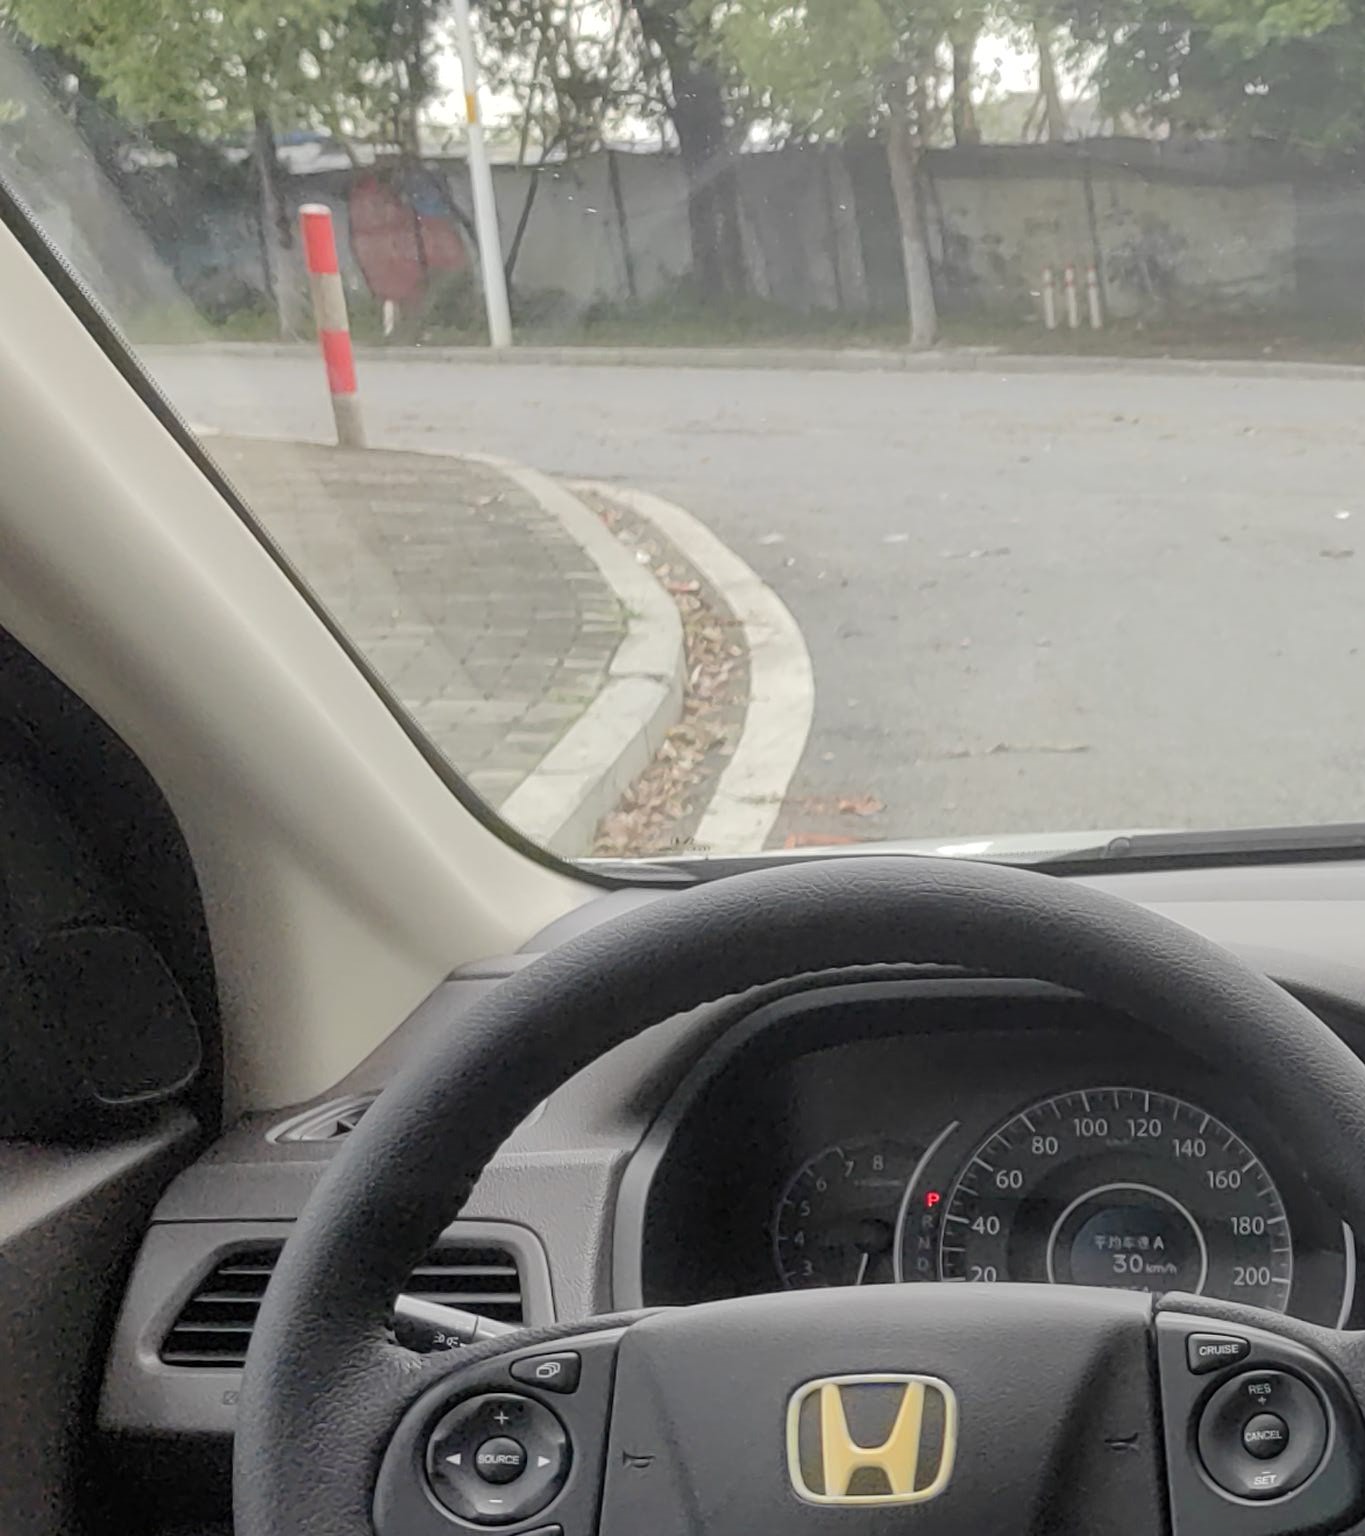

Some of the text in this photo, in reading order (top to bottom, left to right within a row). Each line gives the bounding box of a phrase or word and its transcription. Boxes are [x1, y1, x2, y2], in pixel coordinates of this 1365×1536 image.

[1074, 1118, 1108, 1136] 100
[1128, 1118, 1162, 1137] 120
[1032, 1136, 1058, 1155] 80
[1173, 1139, 1206, 1157] 140
[845, 1160, 855, 1177] 7
[872, 1155, 884, 1171] 8
[816, 1178, 828, 1192] 6
[996, 1170, 1023, 1189] 60
[1207, 1170, 1241, 1189] 160
[927, 1192, 941, 1208] P
[801, 1203, 811, 1217] 5
[971, 1216, 1000, 1235] 40
[1230, 1216, 1264, 1235] 180
[794, 1230, 805, 1245] 4
[803, 1260, 813, 1276] 3
[1112, 1254, 1144, 1274] 30
[970, 1266, 996, 1282] 20
[1233, 1267, 1271, 1286] 200
[1199, 1344, 1239, 1356] CRUISE
[1248, 1383, 1272, 1395] RES
[1244, 1430, 1283, 1442] CANCEL
[477, 1454, 520, 1466] SOURCE
[1253, 1474, 1278, 1486] SET
